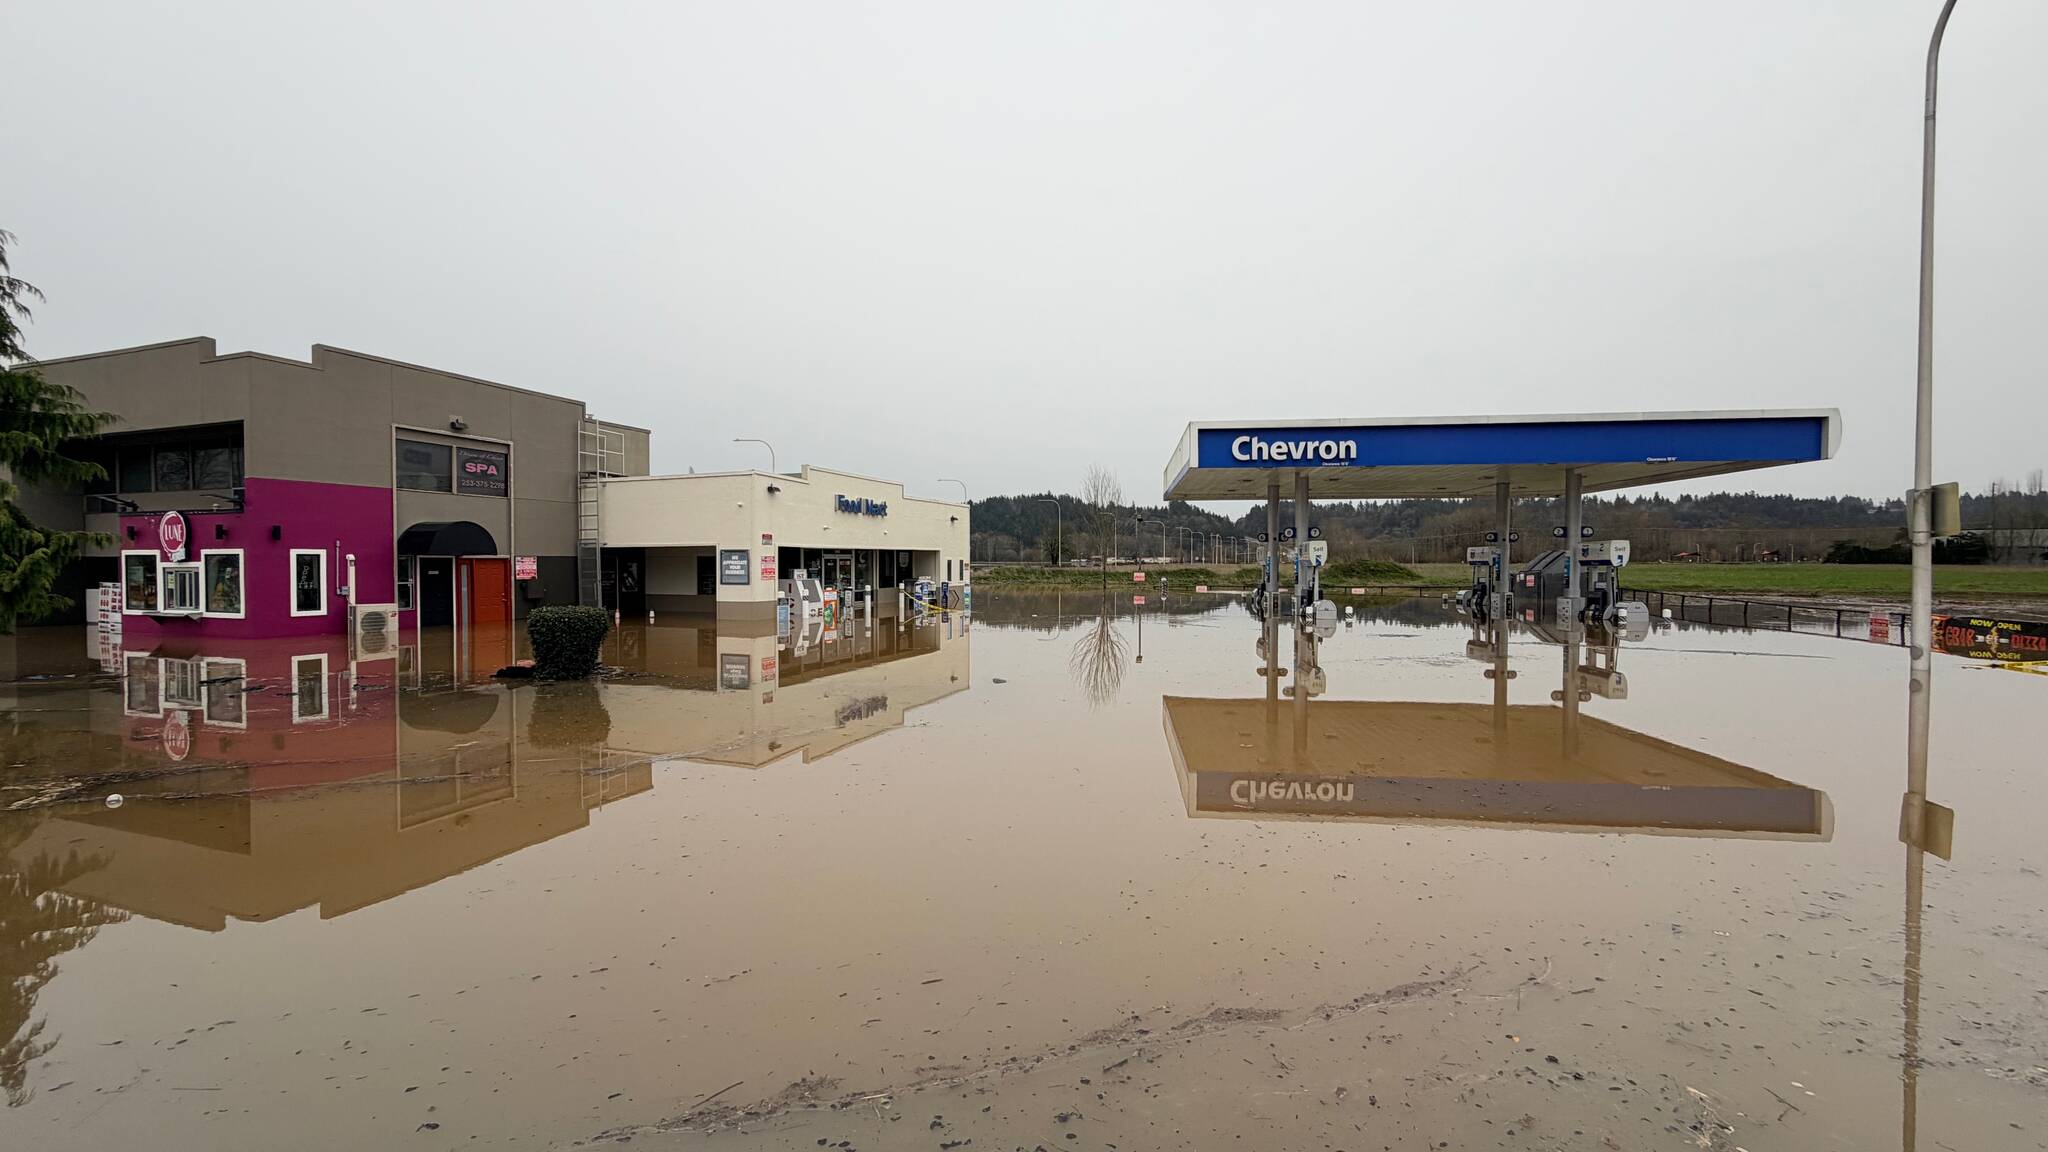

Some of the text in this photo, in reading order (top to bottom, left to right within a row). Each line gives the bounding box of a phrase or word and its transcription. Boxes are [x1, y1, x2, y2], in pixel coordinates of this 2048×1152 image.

[1231, 435, 1357, 461] Chevron
[465, 463, 498, 475] SPA
[834, 494, 861, 514] Food
[164, 524, 183, 542] LUNE
[1969, 619, 2022, 632] NOW OPEN
